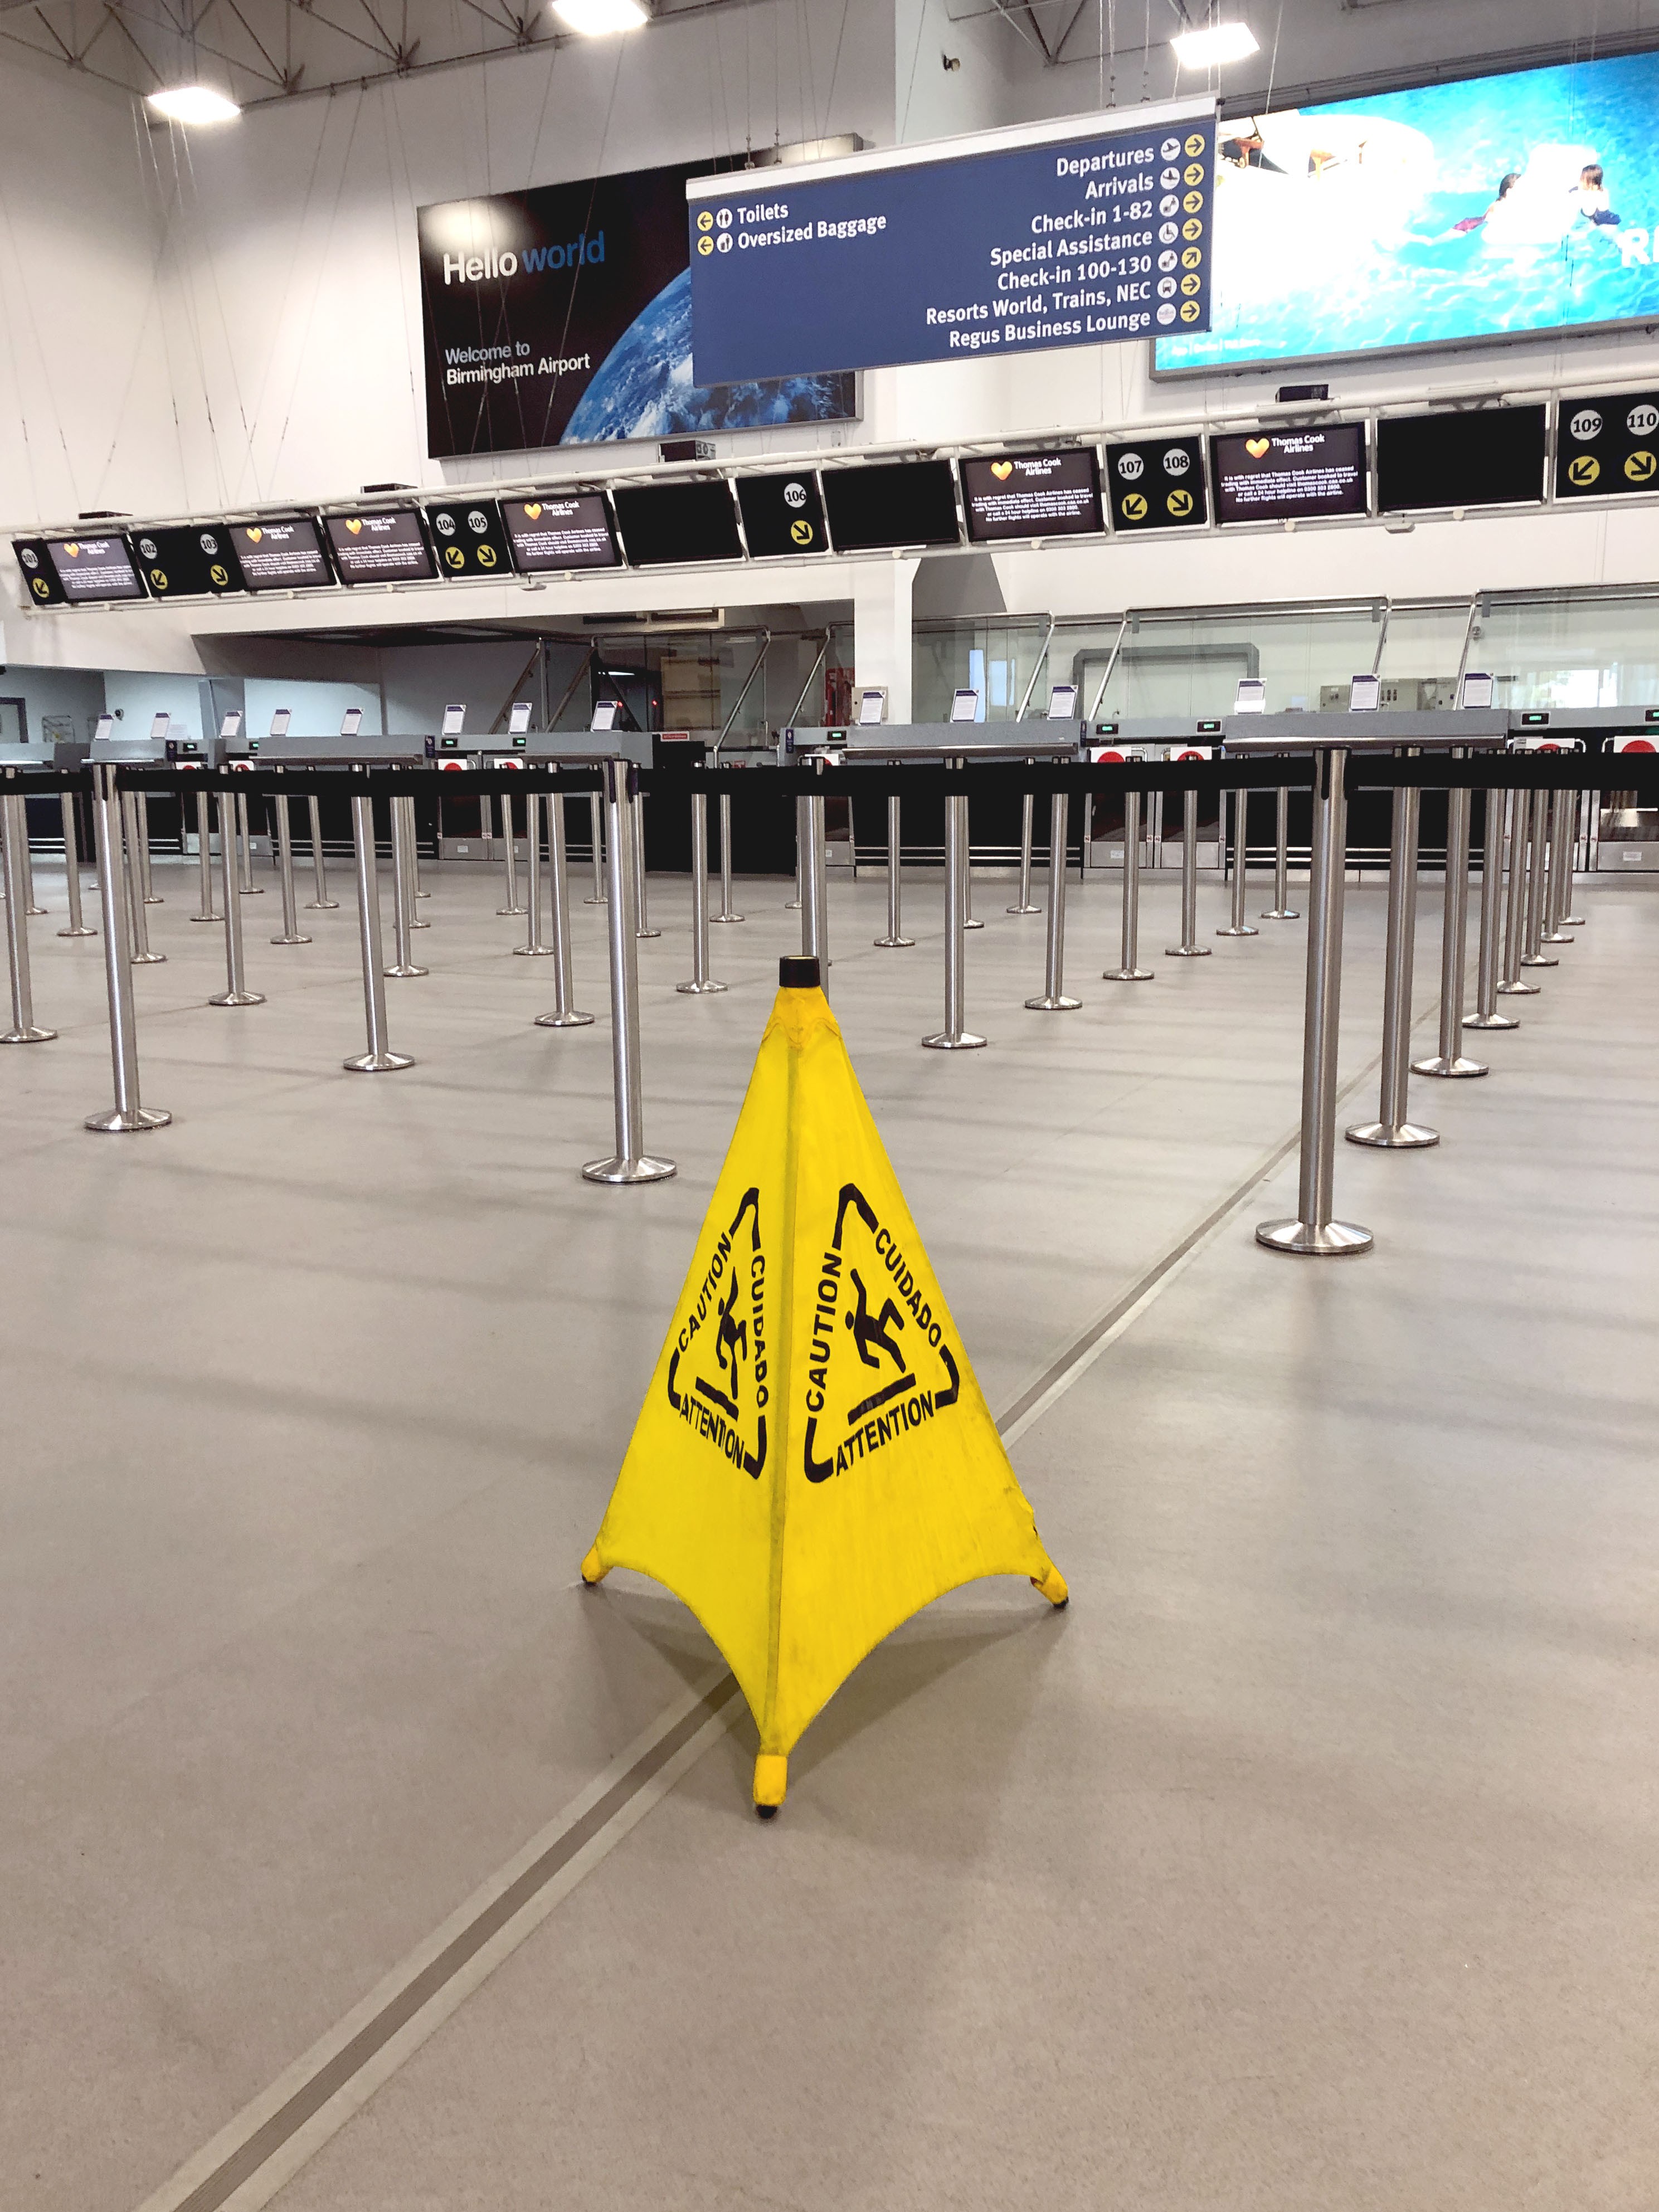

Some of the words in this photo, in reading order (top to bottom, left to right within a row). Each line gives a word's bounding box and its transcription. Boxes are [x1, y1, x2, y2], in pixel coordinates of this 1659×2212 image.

[1057, 146, 1155, 177] Departures
[1085, 172, 1154, 200] Arrivals
[737, 203, 789, 225] Toilets
[1032, 208, 1107, 234] Check-in
[1112, 201, 1152, 223] 1-82
[738, 222, 813, 249] Oversized
[818, 215, 886, 239] Baggage
[443, 247, 518, 285] Hello
[522, 230, 605, 274] world
[990, 241, 1053, 268] Special
[1057, 230, 1152, 257] Assistance
[997, 266, 1071, 291] Check-in
[1078, 255, 1151, 281] 100-130
[926, 304, 988, 325] Resorts
[993, 295, 1048, 318] World,
[1052, 289, 1111, 310] Trains,
[1117, 281, 1151, 303] NEC
[950, 327, 1000, 348] Regus
[1005, 320, 1082, 342] Business
[1087, 311, 1150, 334] Lounge
[445, 345, 512, 365] Welcome
[515, 341, 530, 357] to
[447, 362, 534, 385] Birmingham
[538, 353, 591, 376] Airport
[1574, 418, 1602, 433] 109
[1628, 413, 1657, 428] 110
[1272, 436, 1303, 446] Thomas
[1304, 434, 1325, 443] Cook
[1284, 444, 1313, 454] Airlines
[1014, 460, 1042, 470] Thomas
[1043, 457, 1061, 467] Cook
[1025, 467, 1052, 476] Airlines
[1120, 460, 1142, 474] 107
[1165, 455, 1189, 469] 108
[542, 503, 565, 511] Thomas
[786, 489, 806, 502] 106
[438, 519, 455, 530] 104
[469, 518, 486, 528] 105
[140, 544, 156, 553] 102
[201, 539, 217, 549] 103
[678, 1231, 732, 1352] CAUTION
[875, 1227, 942, 1347] CUIDADO
[751, 1255, 769, 1409] CUIDADO
[806, 1251, 843, 1412] CAUTION
[679, 1393, 745, 1469] ATTENTION
[835, 1390, 935, 1477] ATTENTION
